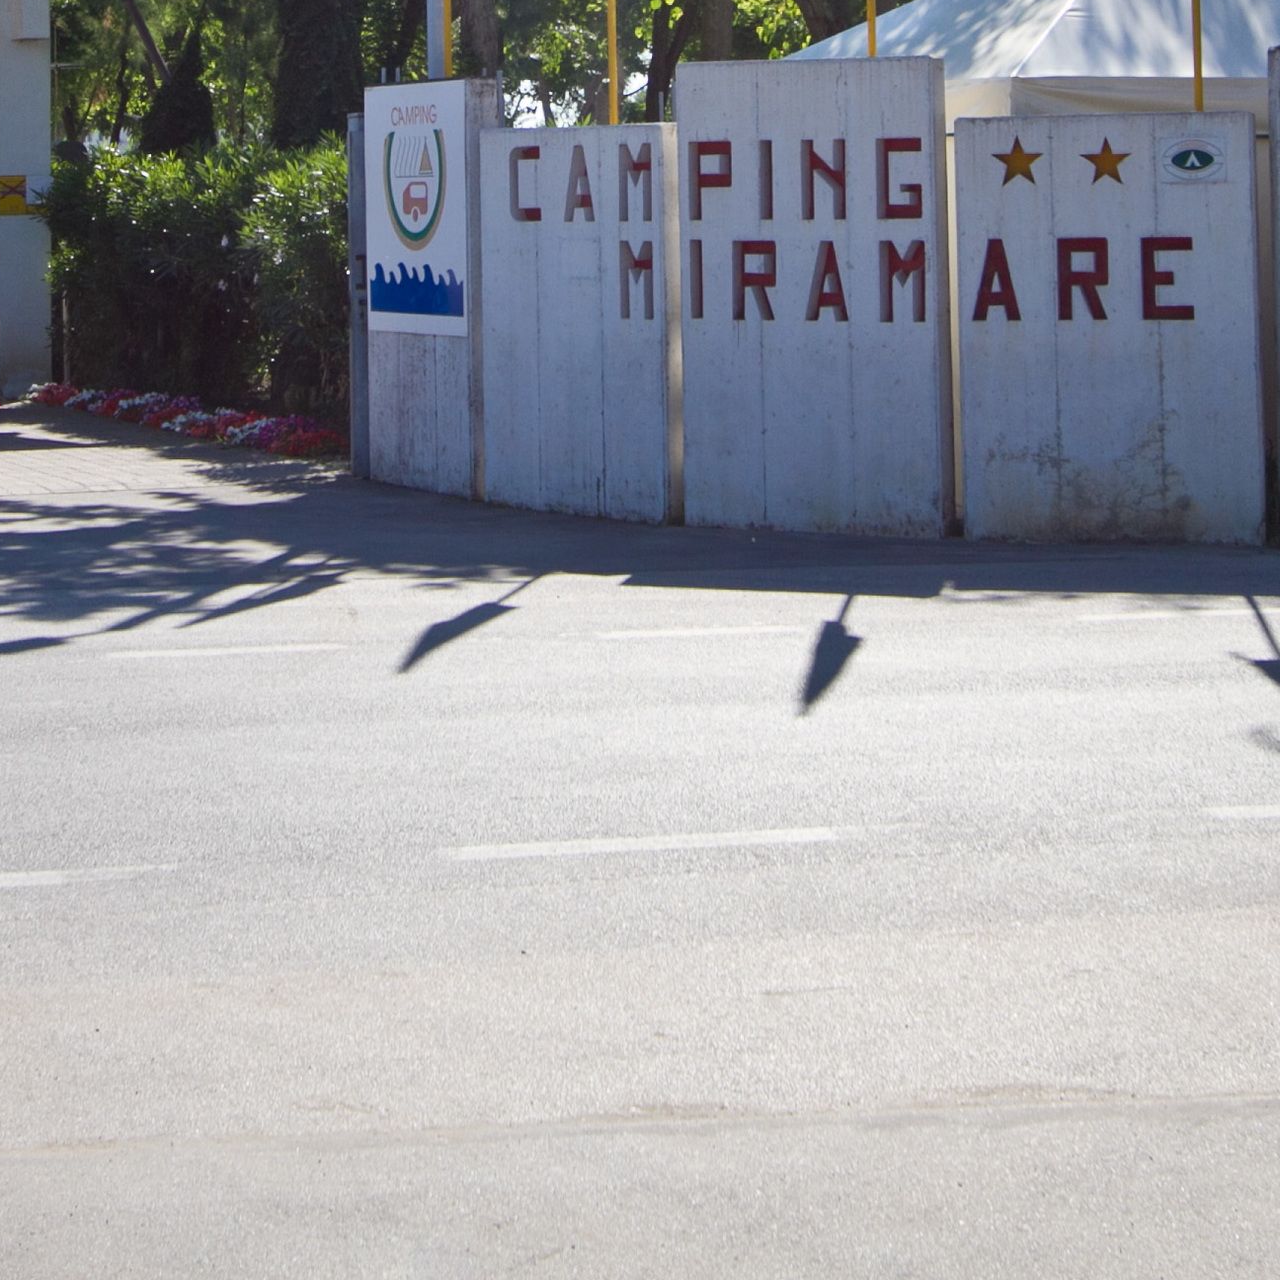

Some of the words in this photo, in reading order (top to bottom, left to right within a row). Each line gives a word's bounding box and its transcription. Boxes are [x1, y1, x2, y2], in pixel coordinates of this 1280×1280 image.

[390, 104, 438, 127] CAMPING
[509, 138, 922, 222] CAMPING
[619, 236, 1195, 323] MIRAMARE
